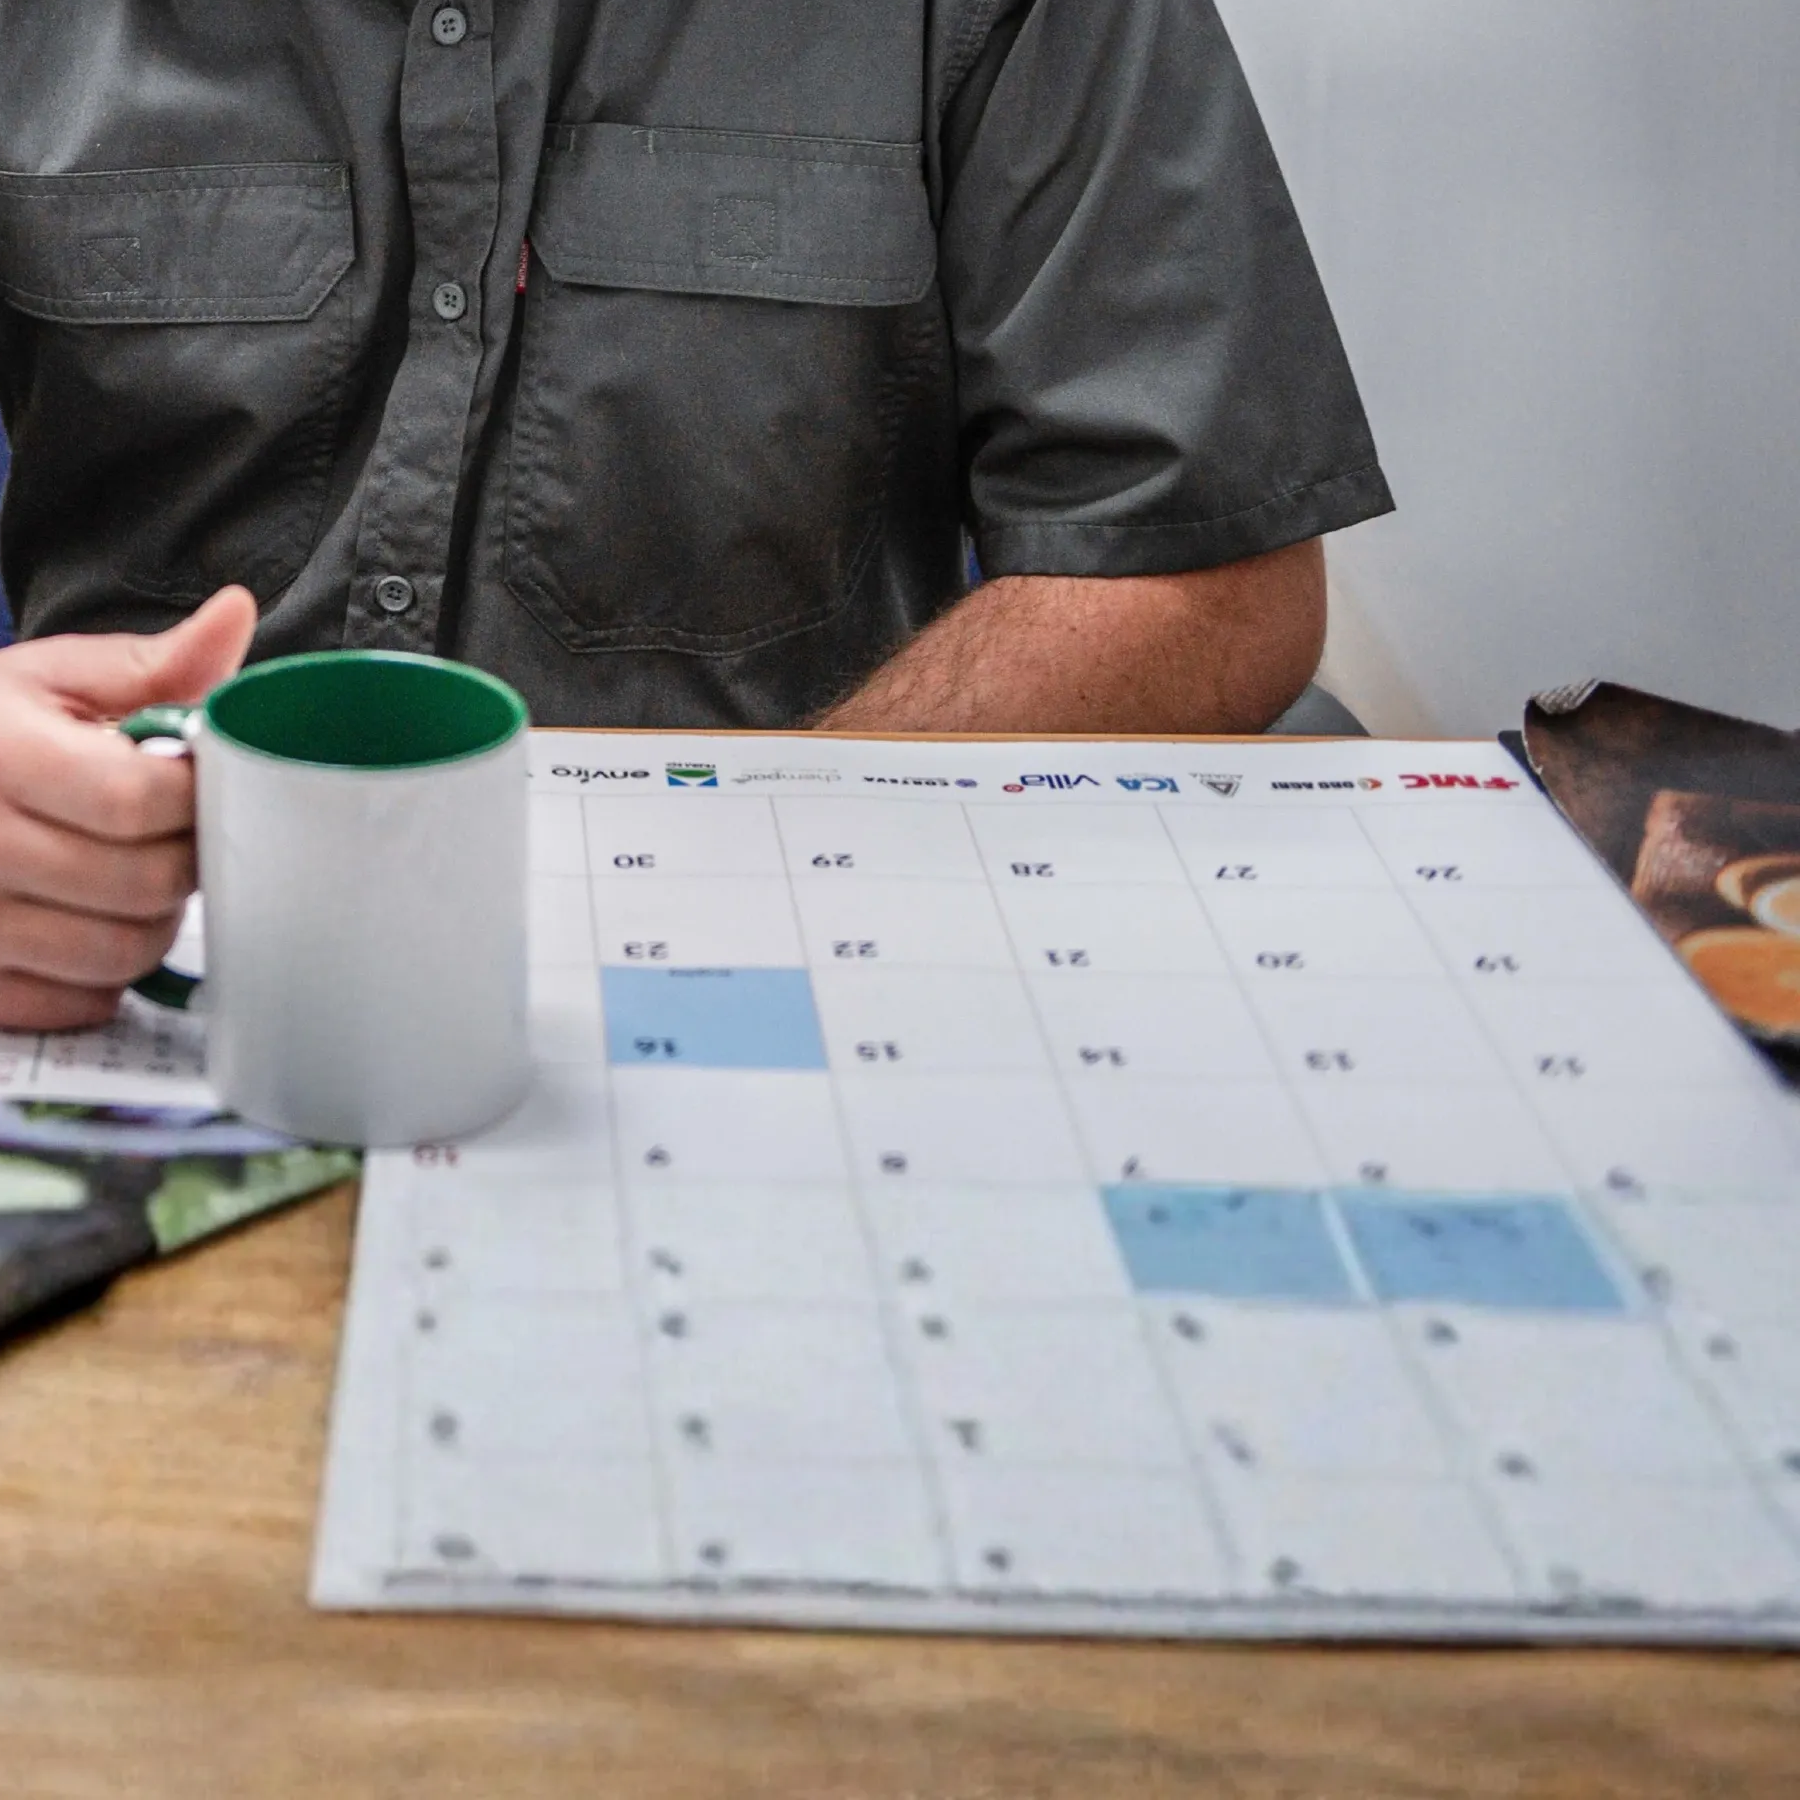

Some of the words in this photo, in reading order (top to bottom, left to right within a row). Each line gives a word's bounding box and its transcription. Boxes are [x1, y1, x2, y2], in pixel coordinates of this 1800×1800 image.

[551, 767, 650, 784] enviro
[864, 777, 949, 787] CORTEVA
[1020, 774, 1101, 790] villa
[1398, 772, 1521, 791] FMC
[1116, 777, 1179, 793] ICA
[613, 855, 654, 868] 30
[812, 854, 853, 868] 29
[1011, 863, 1053, 877] 28
[1216, 866, 1256, 879] 27
[1416, 866, 1461, 881] 26
[624, 942, 667, 959] 23
[834, 941, 877, 958] 22
[1045, 950, 1089, 966] 21
[1256, 953, 1303, 969] 20
[1474, 956, 1519, 973] 19
[633, 1037, 680, 1060] 16
[856, 1042, 901, 1061] 15
[1079, 1048, 1125, 1066] 14
[1305, 1050, 1354, 1071] 13
[1537, 1055, 1587, 1078] 12
